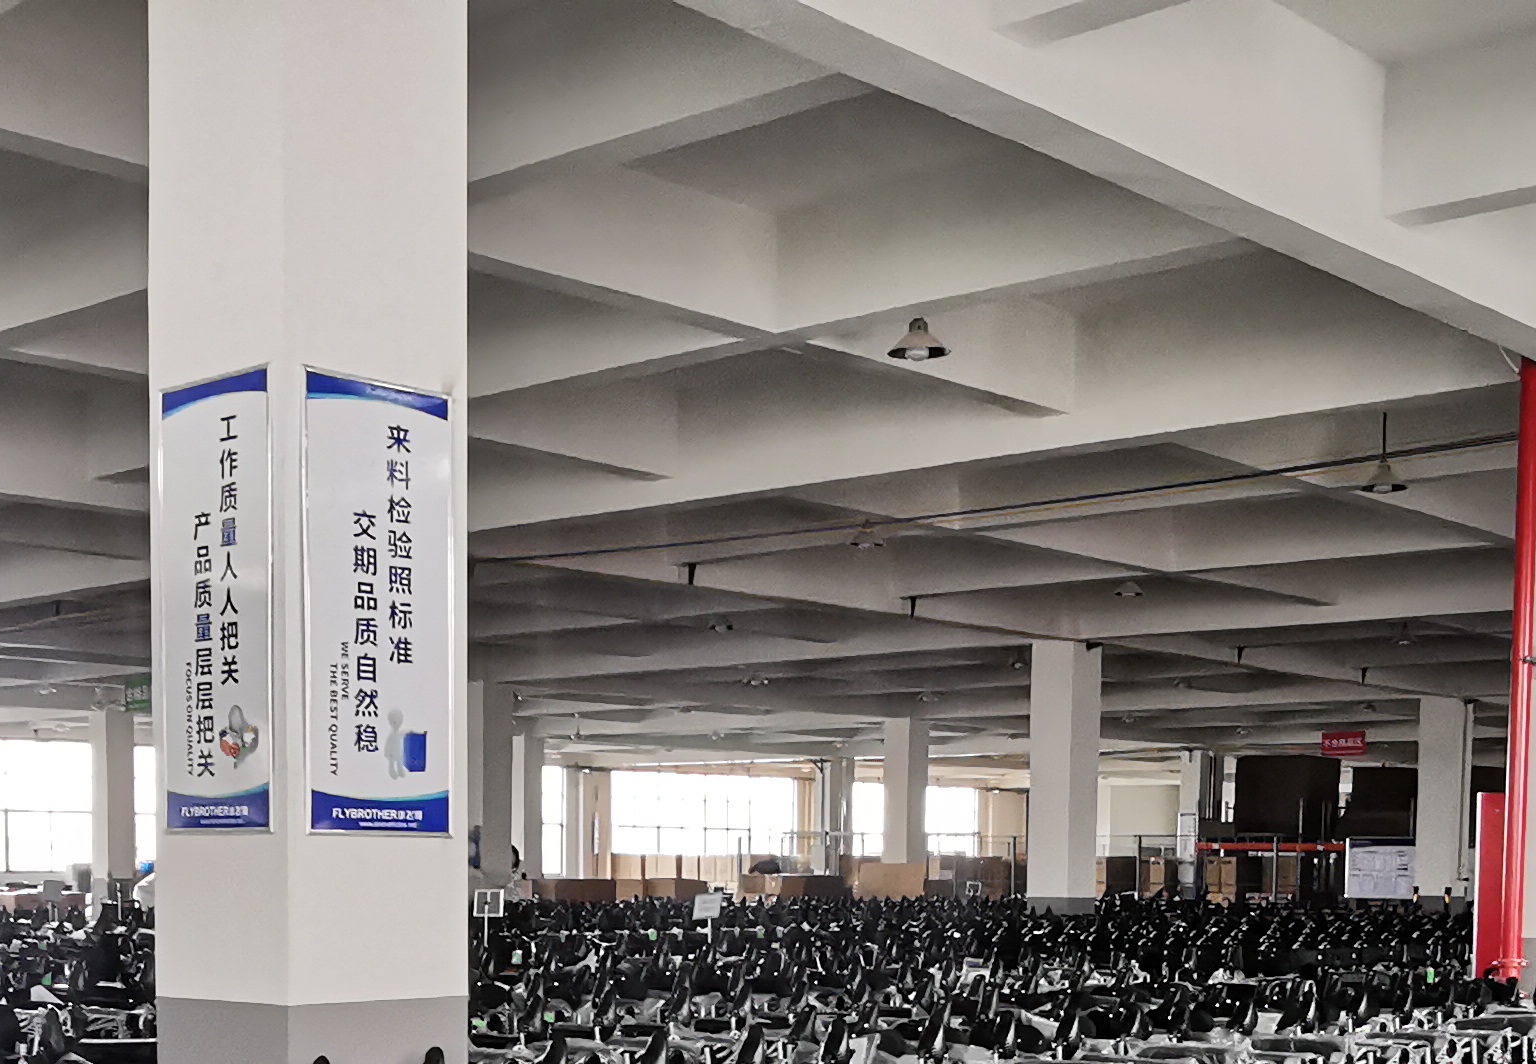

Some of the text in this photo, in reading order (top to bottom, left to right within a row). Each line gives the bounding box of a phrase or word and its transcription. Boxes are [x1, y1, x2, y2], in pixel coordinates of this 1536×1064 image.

[219, 414, 240, 686] 工作质量人人把关
[352, 510, 380, 753] 交期品质自然稳
[386, 424, 414, 665] 来料检验照标准
[185, 661, 195, 777] FOCUS ON QUALITY
[193, 511, 216, 778] 产品质量层层把关
[328, 662, 339, 777] THE BEST QUALITY
[340, 641, 350, 701] WE SERVE
[332, 807, 398, 821] FLYBROTHER
